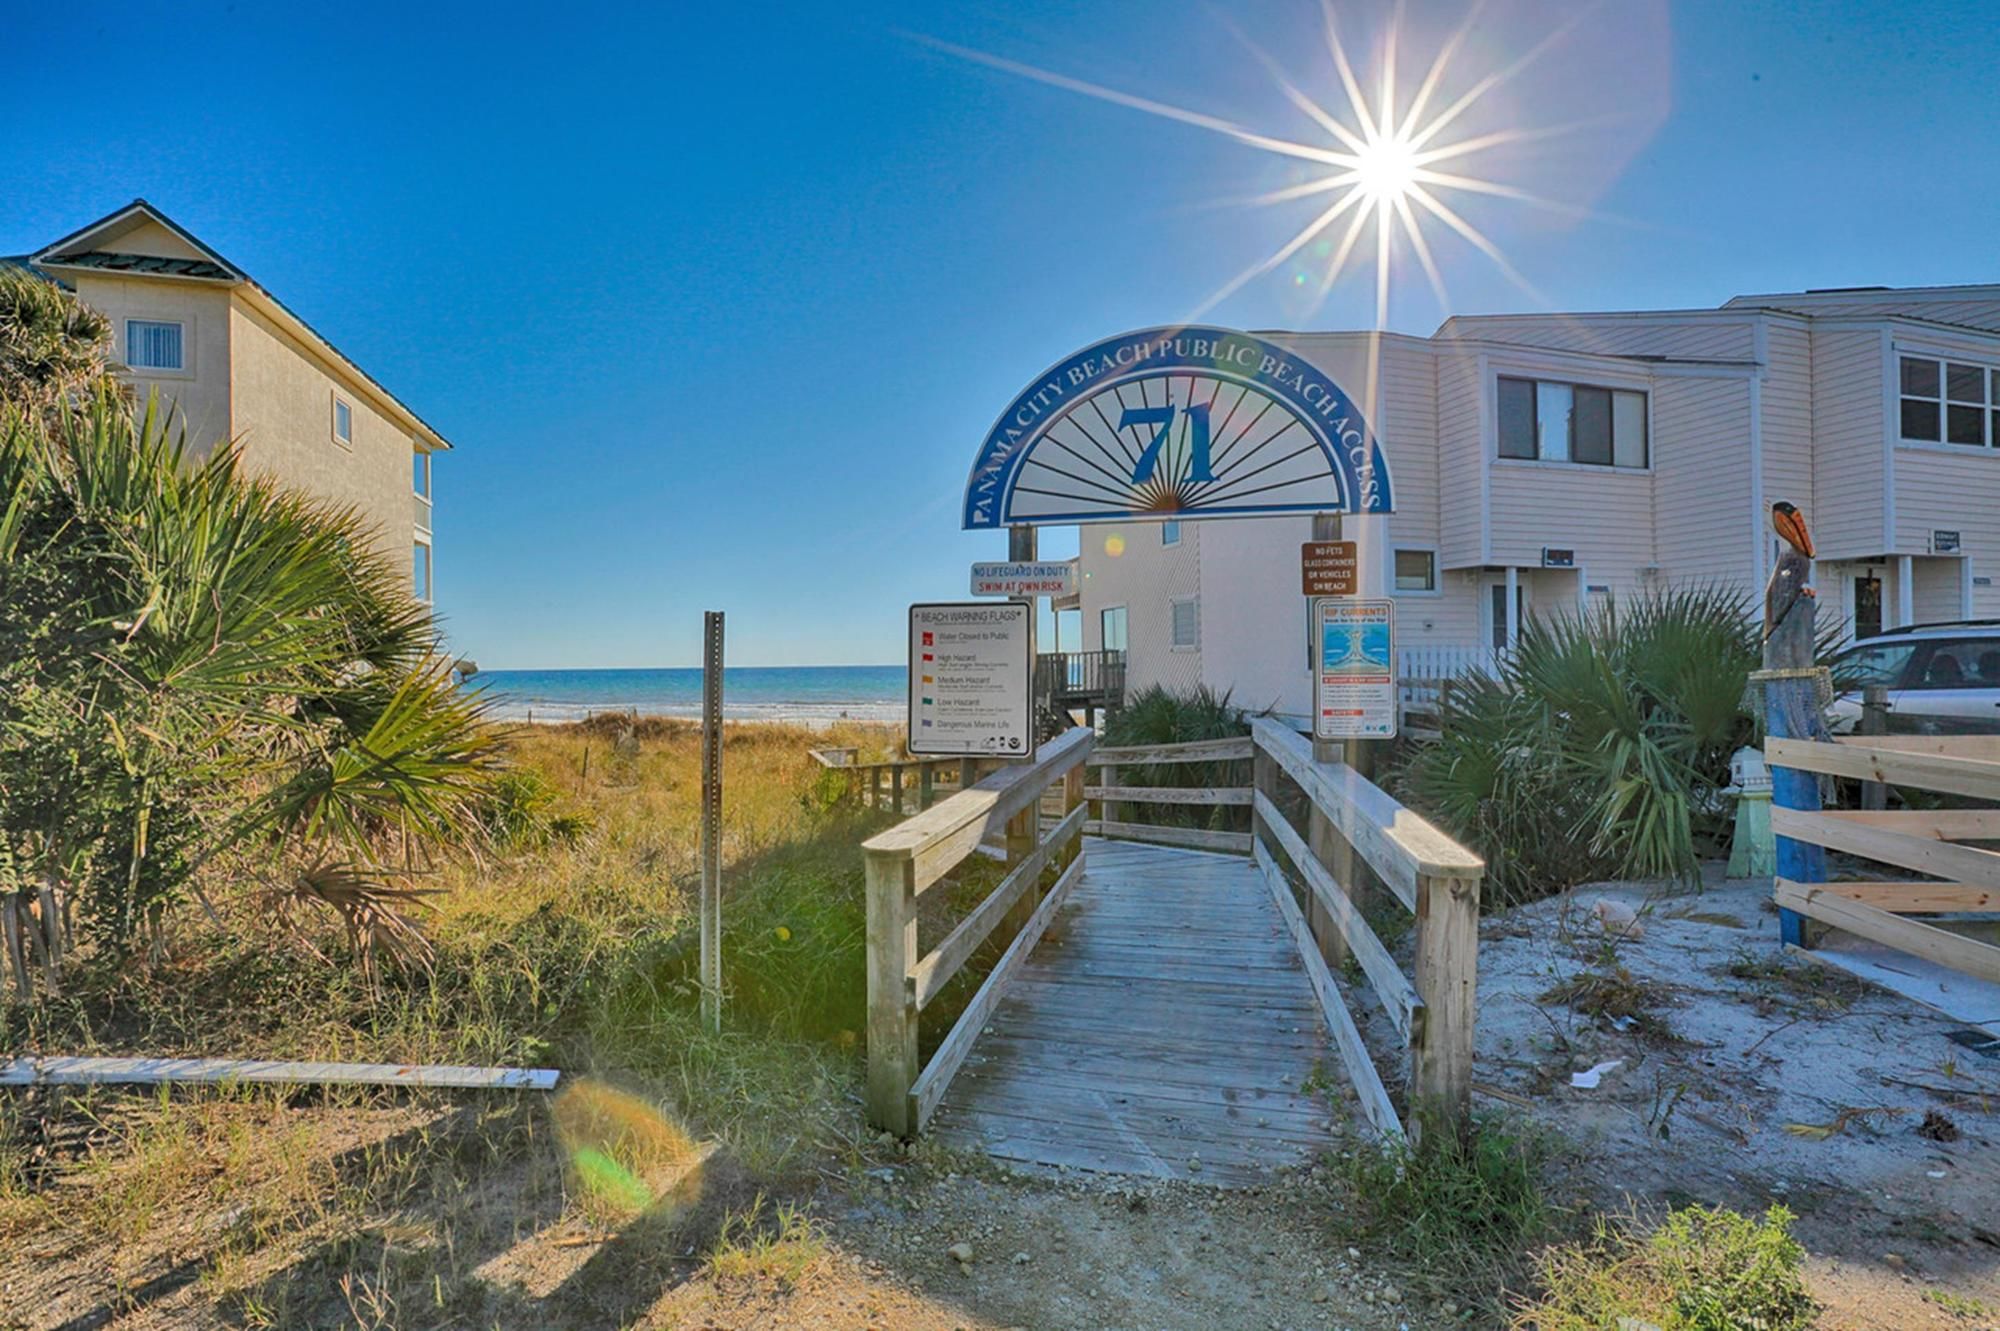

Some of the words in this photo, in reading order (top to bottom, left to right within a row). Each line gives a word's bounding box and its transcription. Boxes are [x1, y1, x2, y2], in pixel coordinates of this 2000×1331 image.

[973, 428, 1022, 524] PANAMA
[1016, 377, 1064, 427] CITY
[1067, 341, 1151, 386] BEACH
[1159, 338, 1256, 367] PUBLIC
[1258, 354, 1339, 416] BEACH
[1329, 415, 1380, 508] ACCESS
[1117, 401, 1220, 485] 71
[1315, 547, 1326, 555] NO
[974, 567, 985, 576] NO
[986, 566, 1032, 577] LIFEGUARD
[1033, 566, 1045, 577] ON
[1046, 566, 1069, 576] DUTY
[1319, 570, 1351, 578] VEHICLES
[979, 582, 1003, 592] SWIM
[1005, 581, 1016, 592] AT
[1018, 581, 1040, 592] OWN
[1041, 581, 1064, 592] RISK
[1324, 582, 1346, 591] BEACH
[921, 611, 948, 622] BEACH
[950, 611, 988, 621] WARNING
[990, 609, 1017, 620] FLAGS
[959, 632, 981, 640] Closed
[990, 632, 1009, 640] Public
[938, 654, 951, 662] High
[937, 698, 952, 706] Low
[954, 698, 980, 706] Hazard
[937, 720, 972, 729] Dangerous
[974, 720, 996, 728] Marine
[998, 720, 1010, 729] Life
